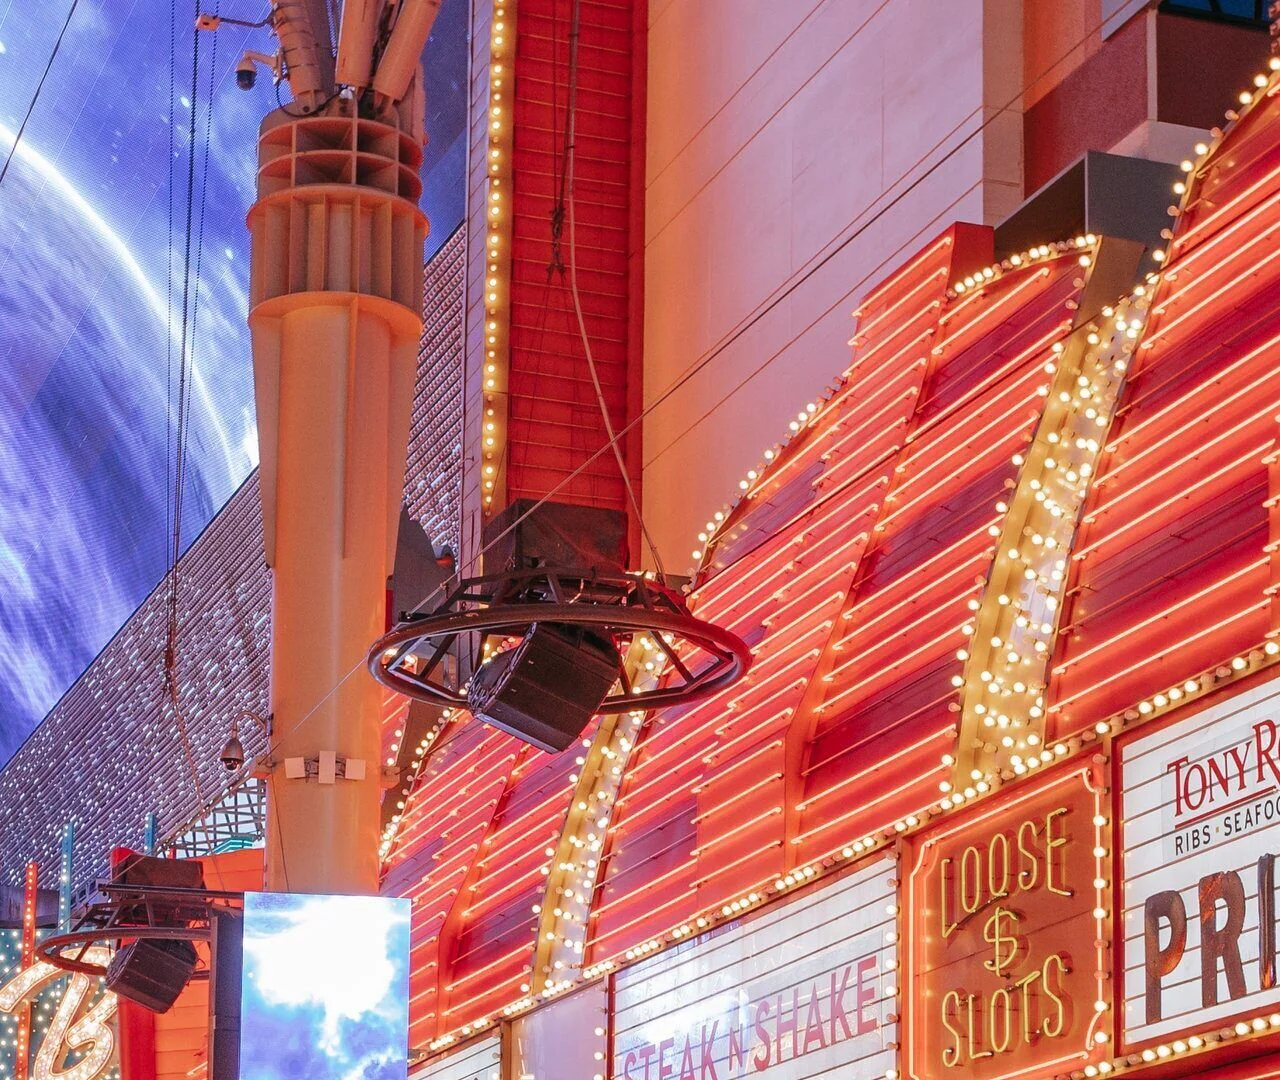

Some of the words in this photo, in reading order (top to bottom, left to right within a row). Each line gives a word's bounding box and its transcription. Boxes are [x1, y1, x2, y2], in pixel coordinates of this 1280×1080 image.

[940, 807, 1075, 938] LOOSE
[1175, 825, 1211, 856] RIBS
[753, 955, 878, 1072] SHAKE
[942, 954, 1072, 1068] SLOTS
